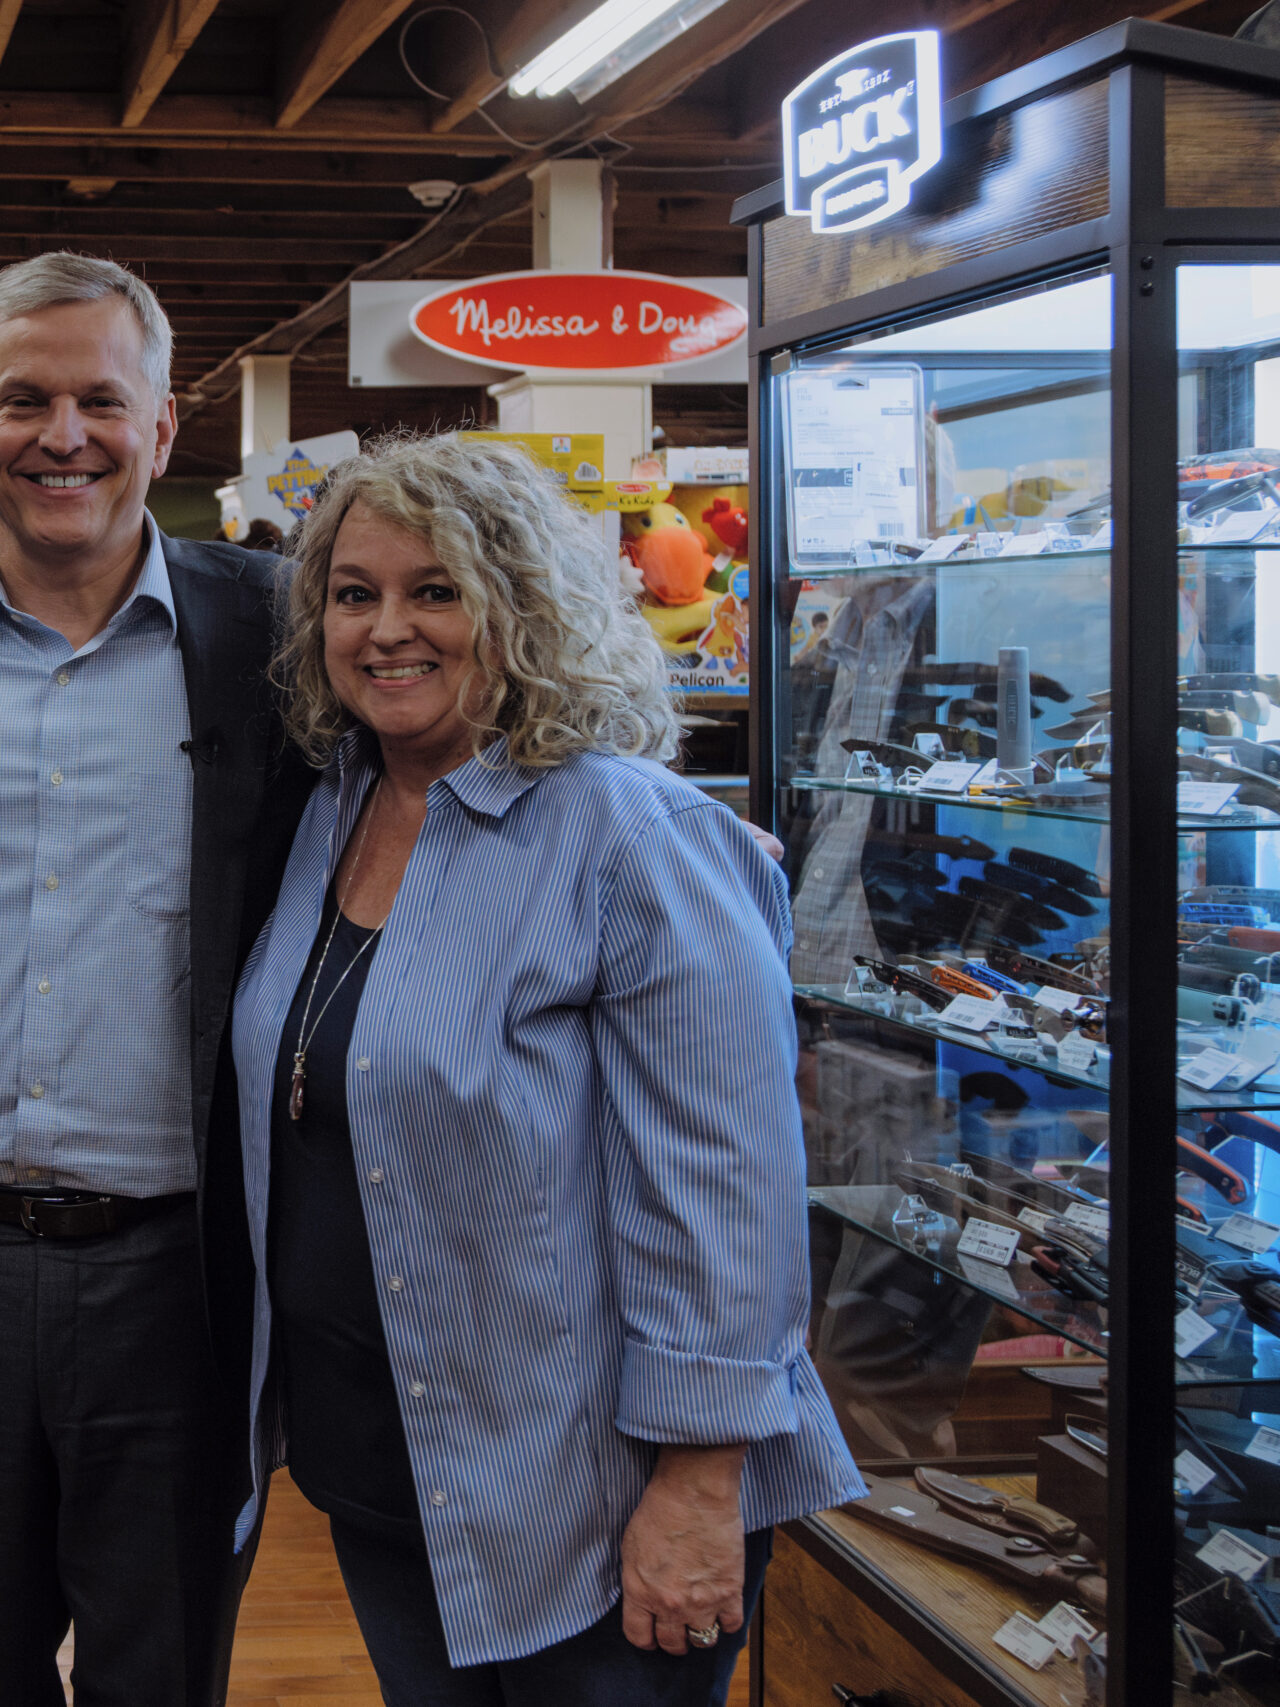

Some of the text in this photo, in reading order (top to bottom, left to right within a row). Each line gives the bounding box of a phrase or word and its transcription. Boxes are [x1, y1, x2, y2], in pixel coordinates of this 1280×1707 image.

[798, 86, 912, 178] BUCK
[449, 297, 718, 353] Melissa & Doug
[670, 672, 725, 687] Pelican
